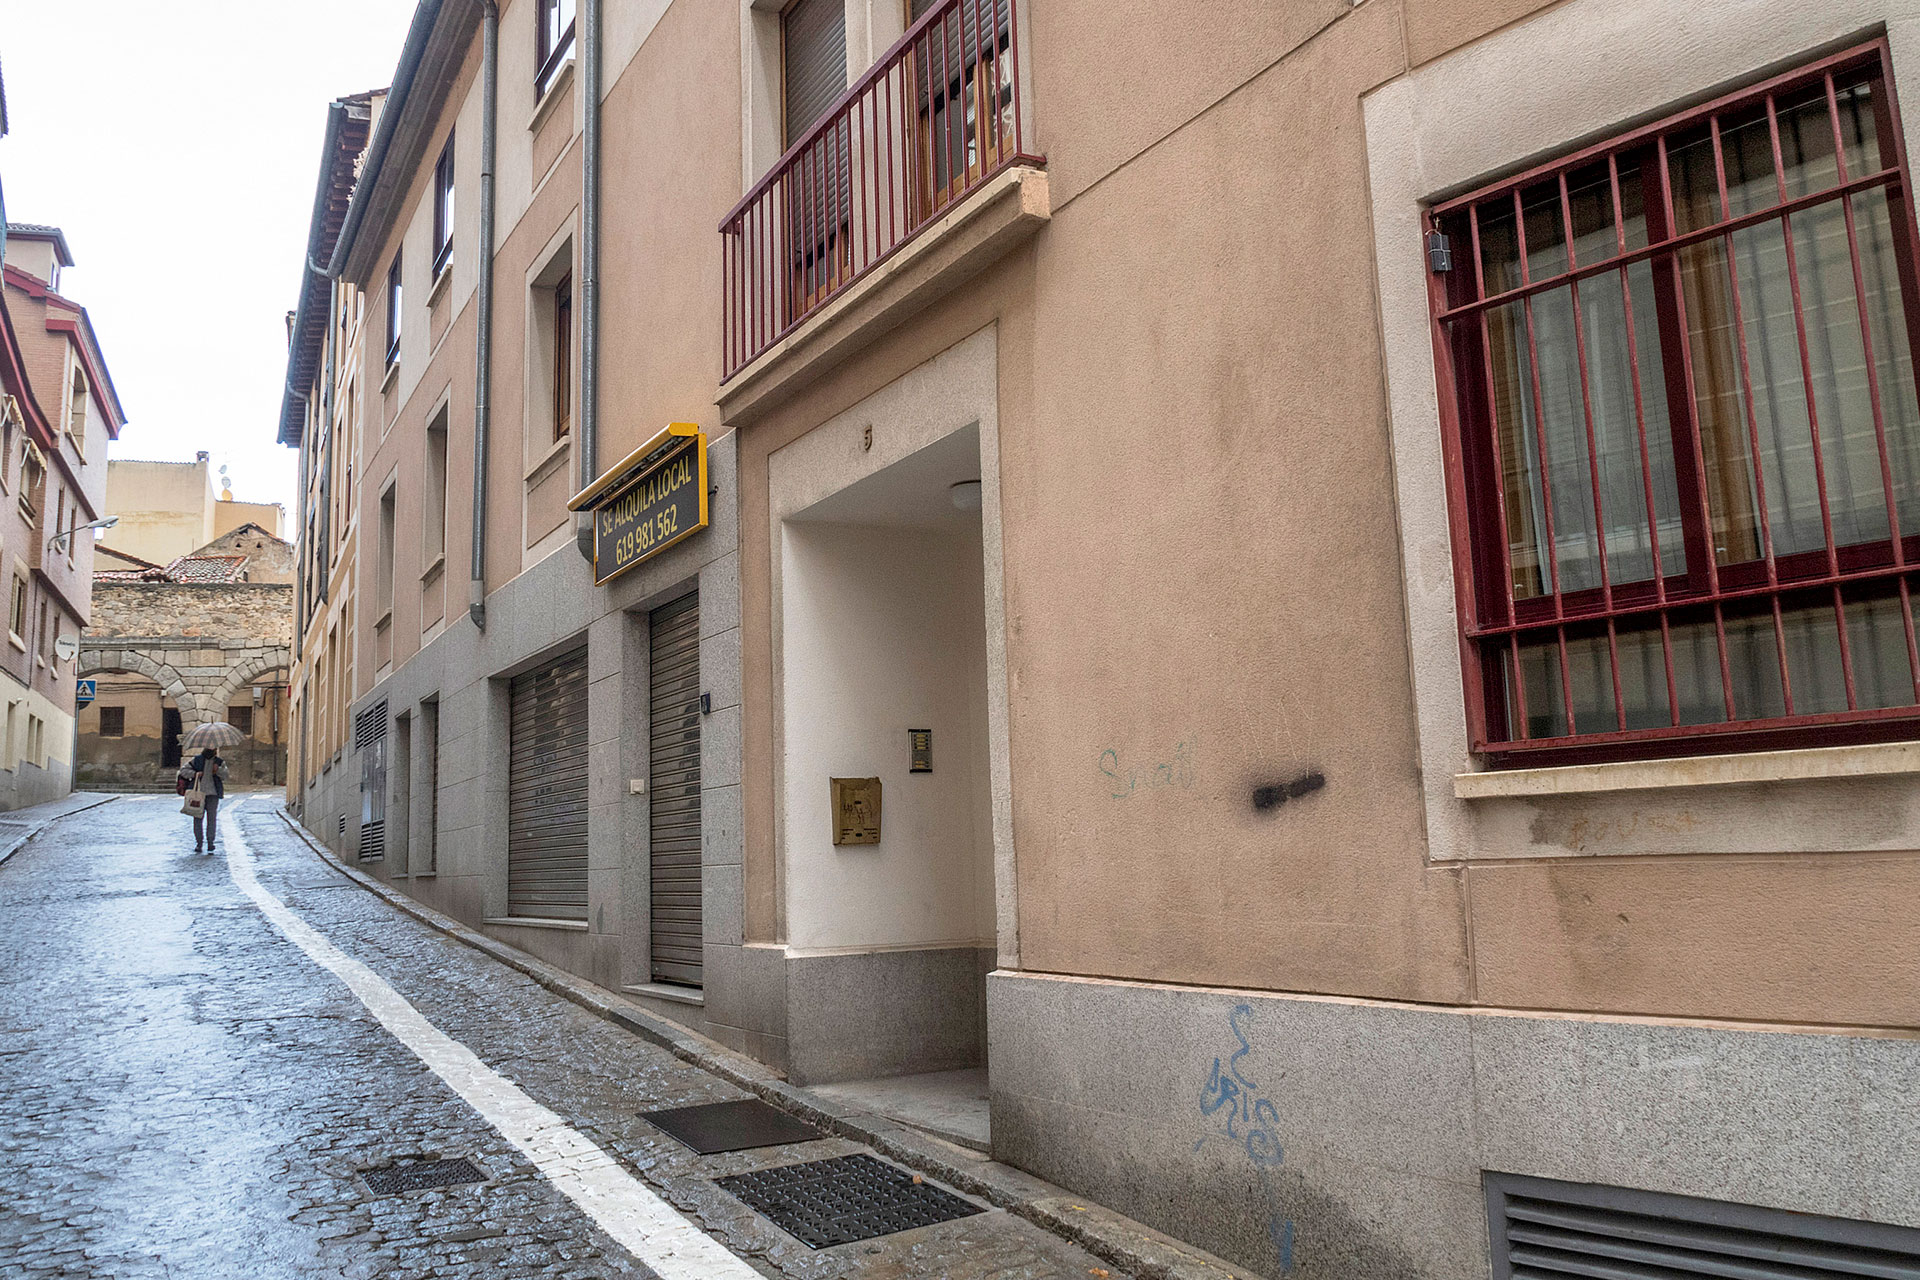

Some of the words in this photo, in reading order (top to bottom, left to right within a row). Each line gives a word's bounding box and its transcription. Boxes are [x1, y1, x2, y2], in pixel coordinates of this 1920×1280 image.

[602, 508, 613, 537] SE
[614, 479, 656, 529] ALQUILA
[657, 455, 691, 500] LOCAL
[616, 531, 634, 565] 619
[635, 518, 655, 554] 981
[657, 503, 678, 541] 562
